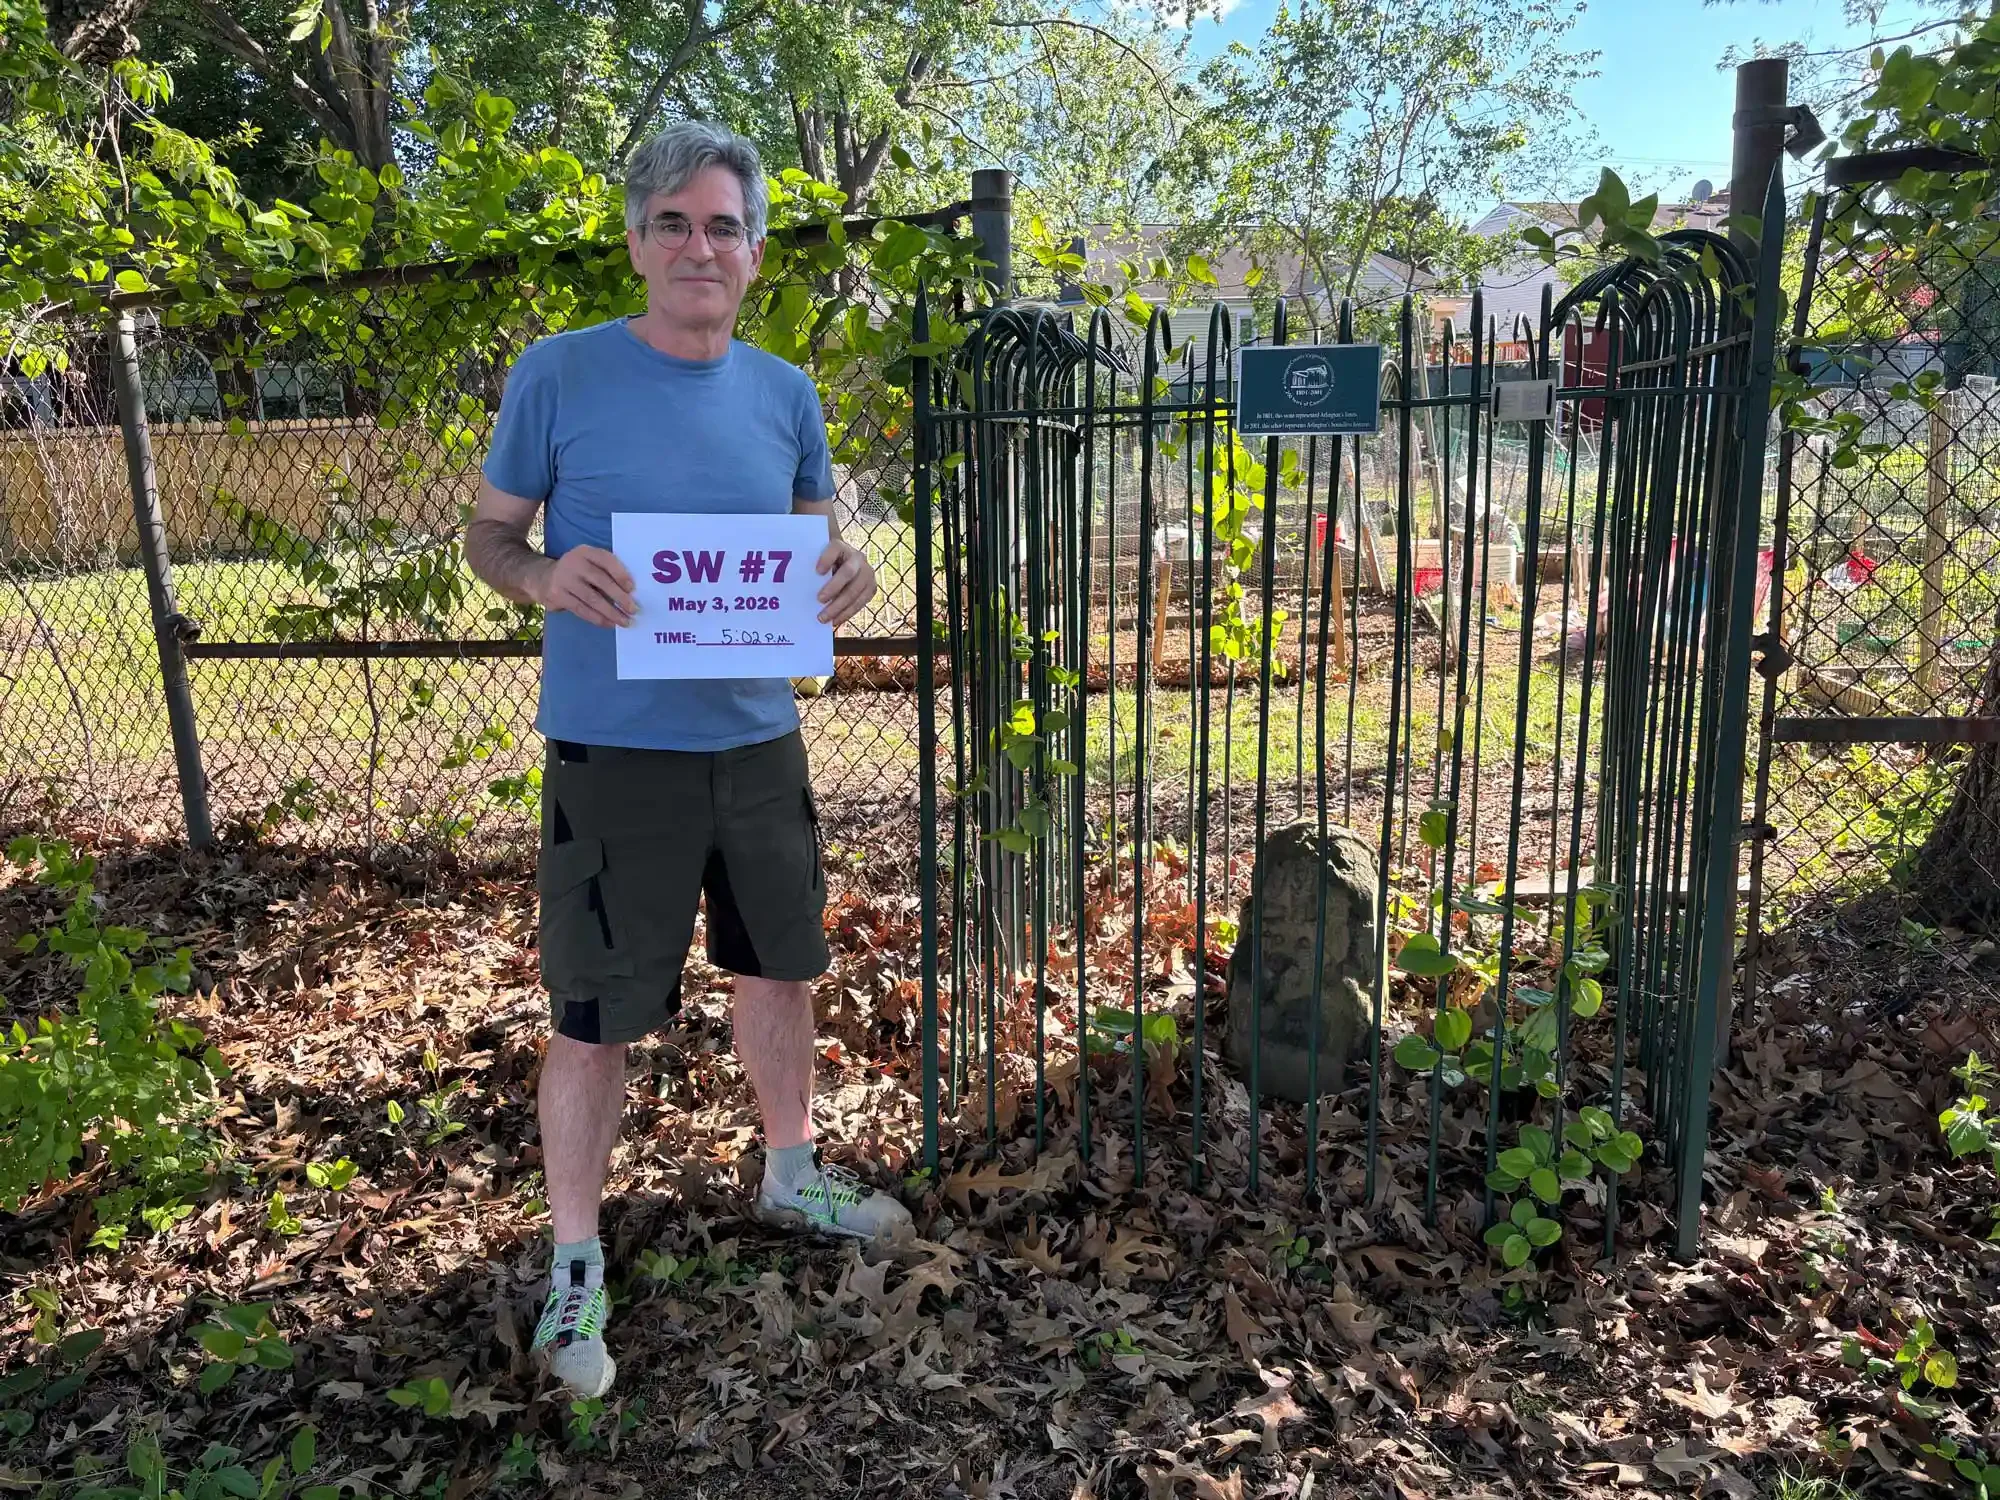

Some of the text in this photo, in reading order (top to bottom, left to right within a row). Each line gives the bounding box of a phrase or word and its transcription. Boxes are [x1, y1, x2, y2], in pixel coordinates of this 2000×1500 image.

[651, 550, 793, 584] SW #7
[668, 596, 780, 613] May 3, 2026
[654, 632, 696, 644] TIME:
[721, 628, 762, 645] 5:02
